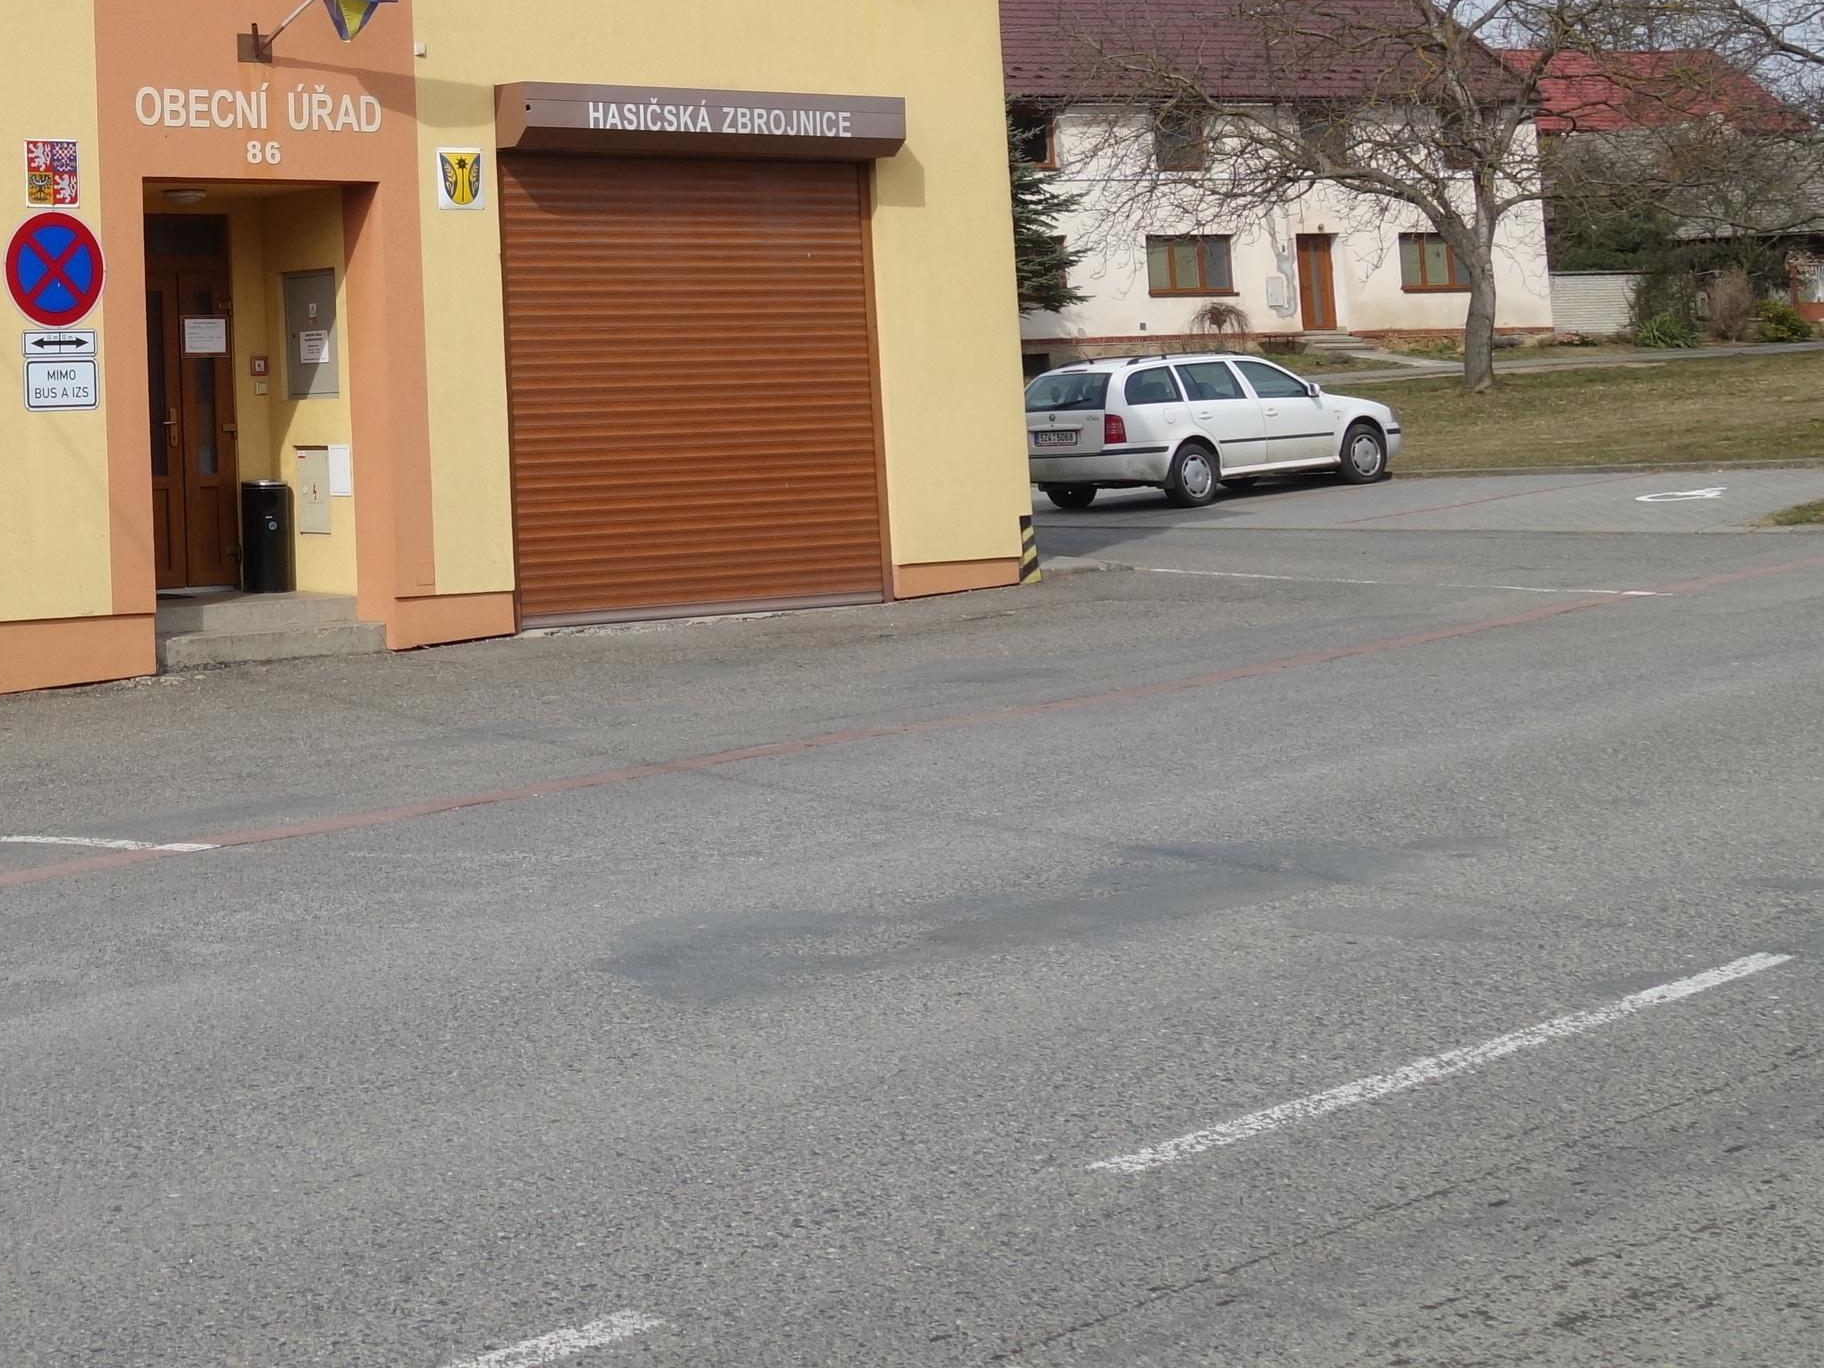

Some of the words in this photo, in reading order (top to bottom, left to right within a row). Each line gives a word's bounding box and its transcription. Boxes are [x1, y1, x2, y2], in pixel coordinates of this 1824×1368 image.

[134, 82, 270, 130] OBECNÍ
[287, 83, 383, 132] ÚŘAD
[588, 97, 713, 133] HASIČSKÁ
[722, 106, 853, 138] ZBROJNICE
[246, 140, 281, 165] 86
[47, 369, 77, 381] MIMO
[34, 387, 57, 399] BUS
[61, 387, 69, 399] A
[72, 386, 89, 398] IZS
